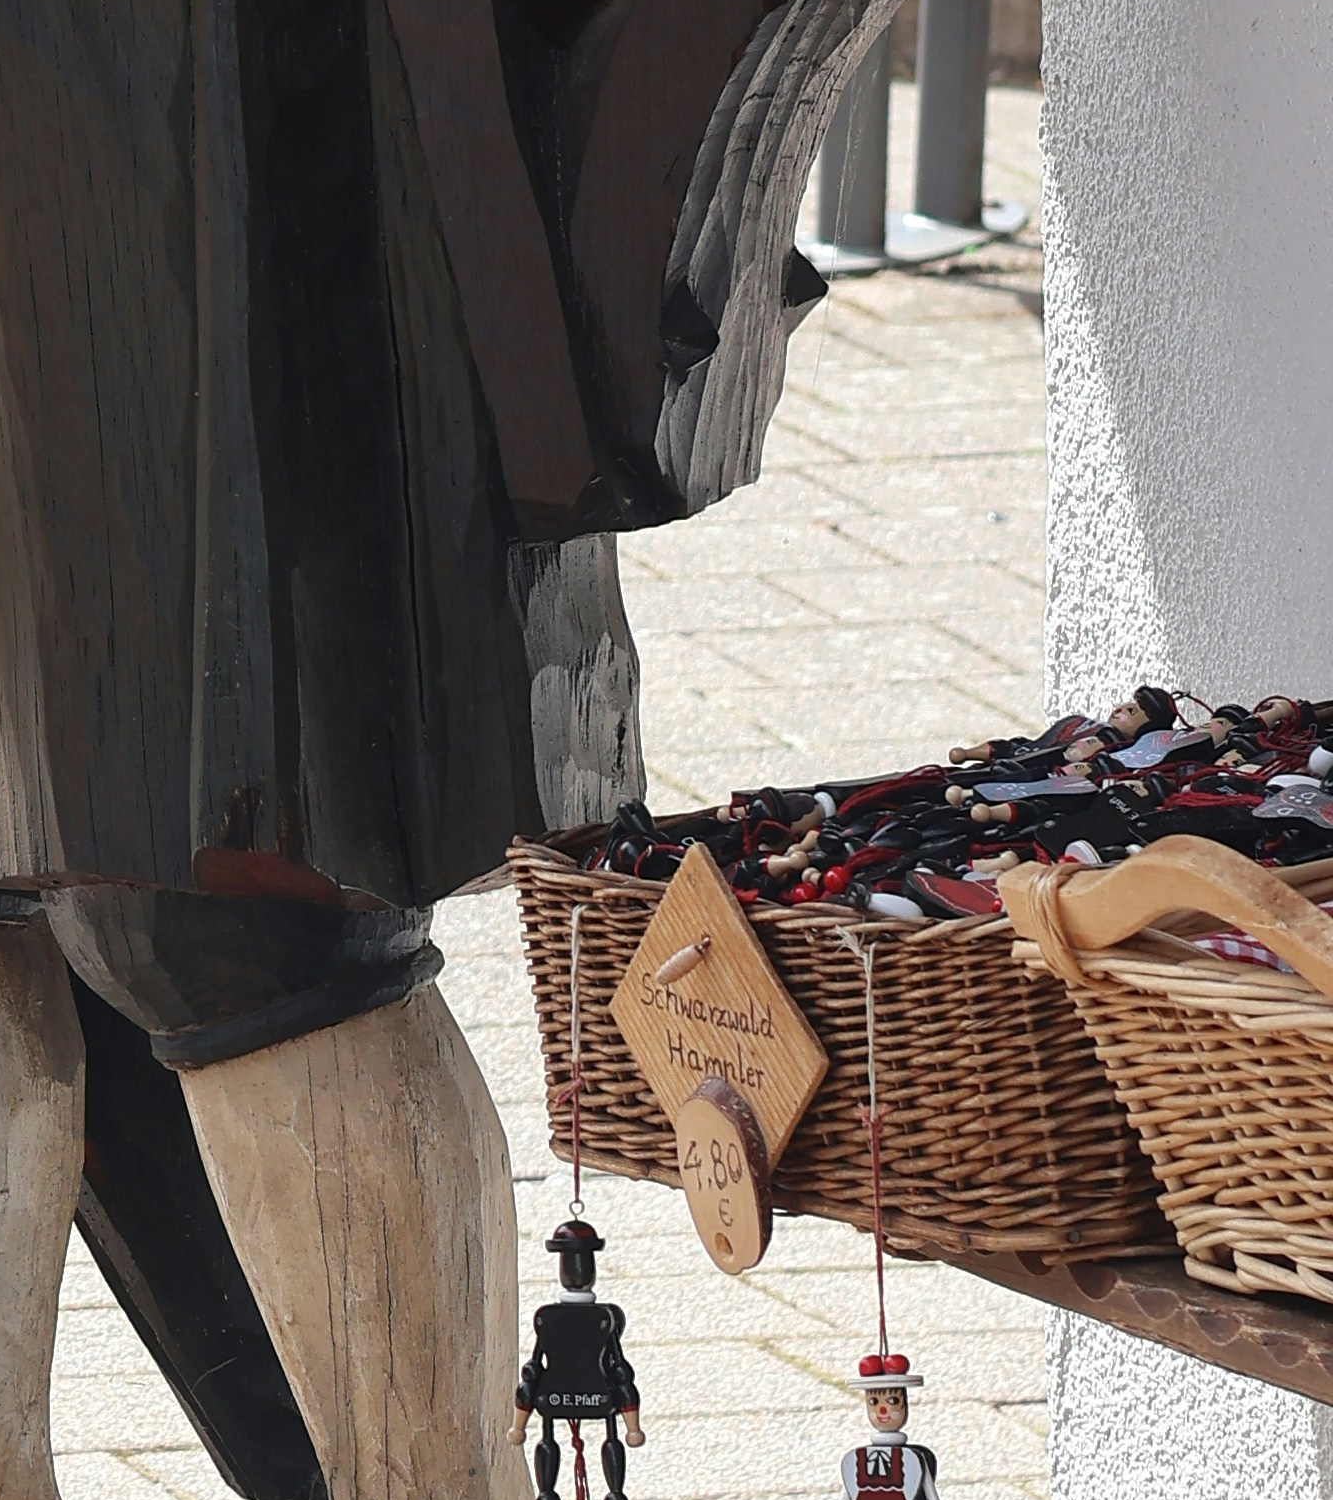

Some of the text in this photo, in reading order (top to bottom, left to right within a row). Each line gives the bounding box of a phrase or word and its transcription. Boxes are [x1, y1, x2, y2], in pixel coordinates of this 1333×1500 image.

[640, 972, 774, 1039] Schwarzwald
[683, 1138, 743, 1192] 4.80
[718, 1198, 734, 1228] €
[574, 1393, 602, 1406] Pfaff
